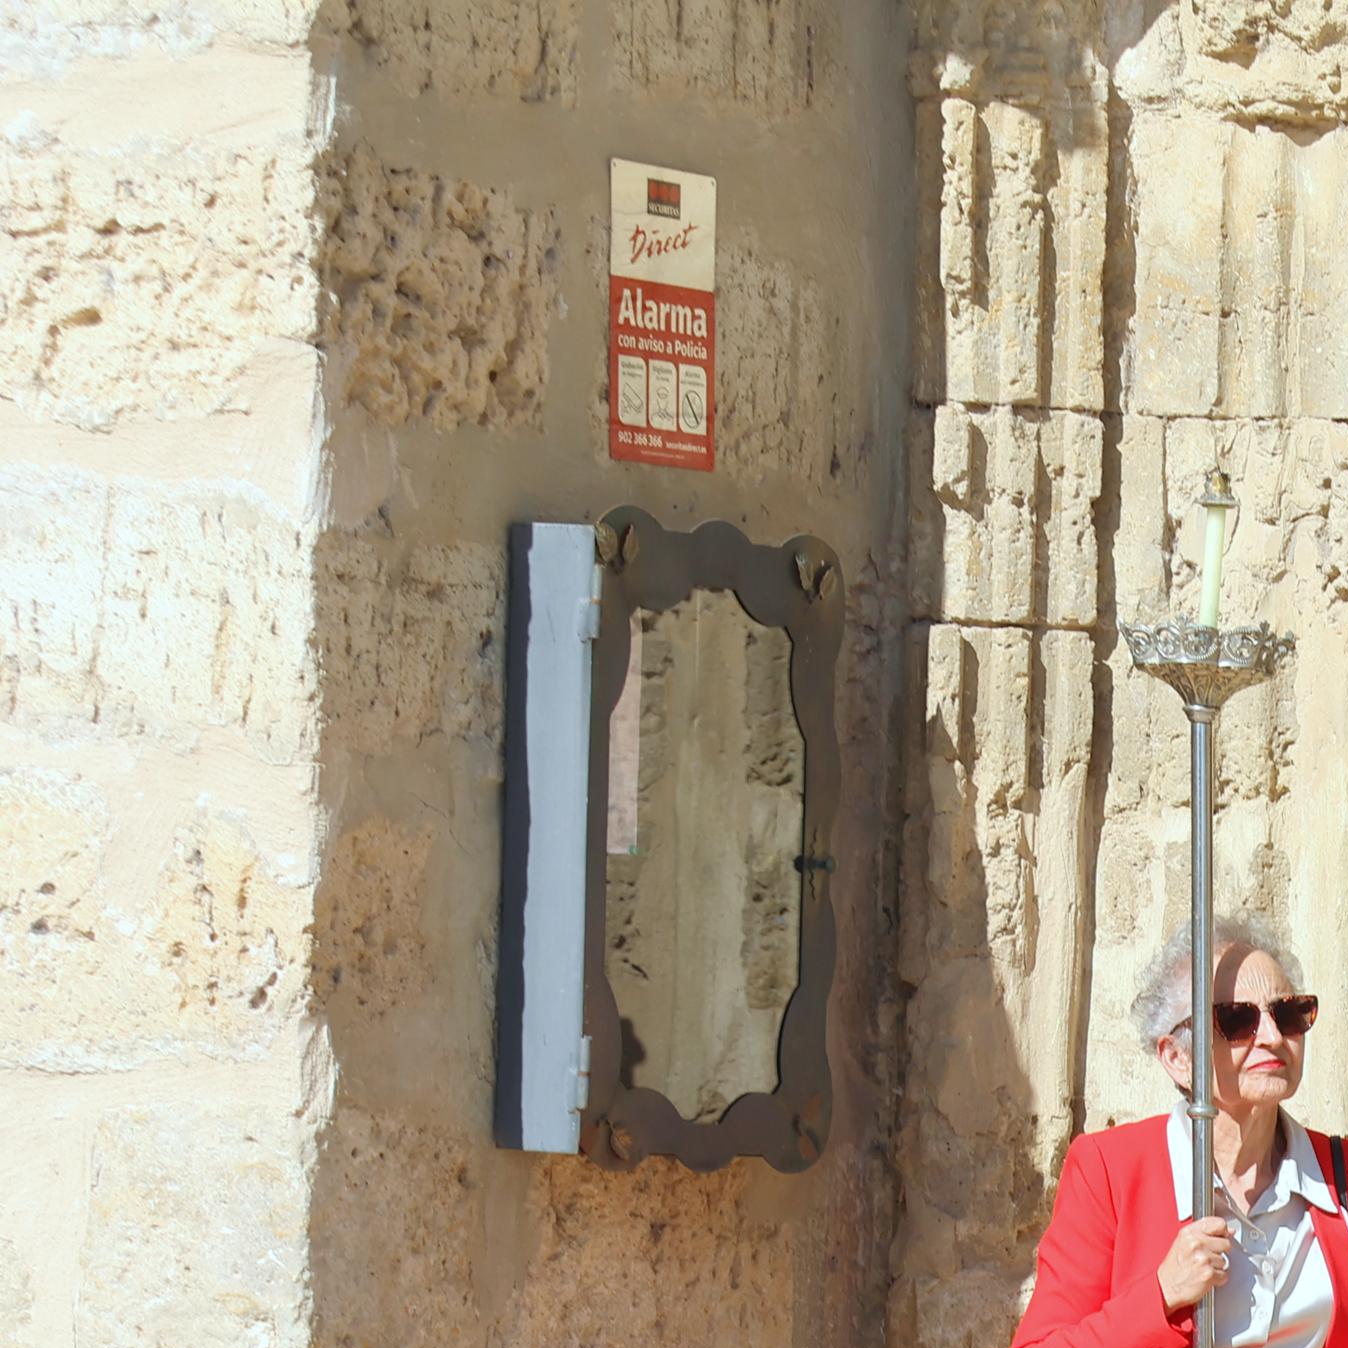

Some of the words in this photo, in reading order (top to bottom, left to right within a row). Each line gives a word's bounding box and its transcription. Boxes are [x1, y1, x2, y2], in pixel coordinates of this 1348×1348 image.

[629, 221, 699, 265] Direct
[618, 287, 707, 339] Alarma
[618, 333, 637, 349] con
[638, 333, 665, 353] aviso
[666, 341, 673, 354] a
[618, 430, 633, 444] 902
